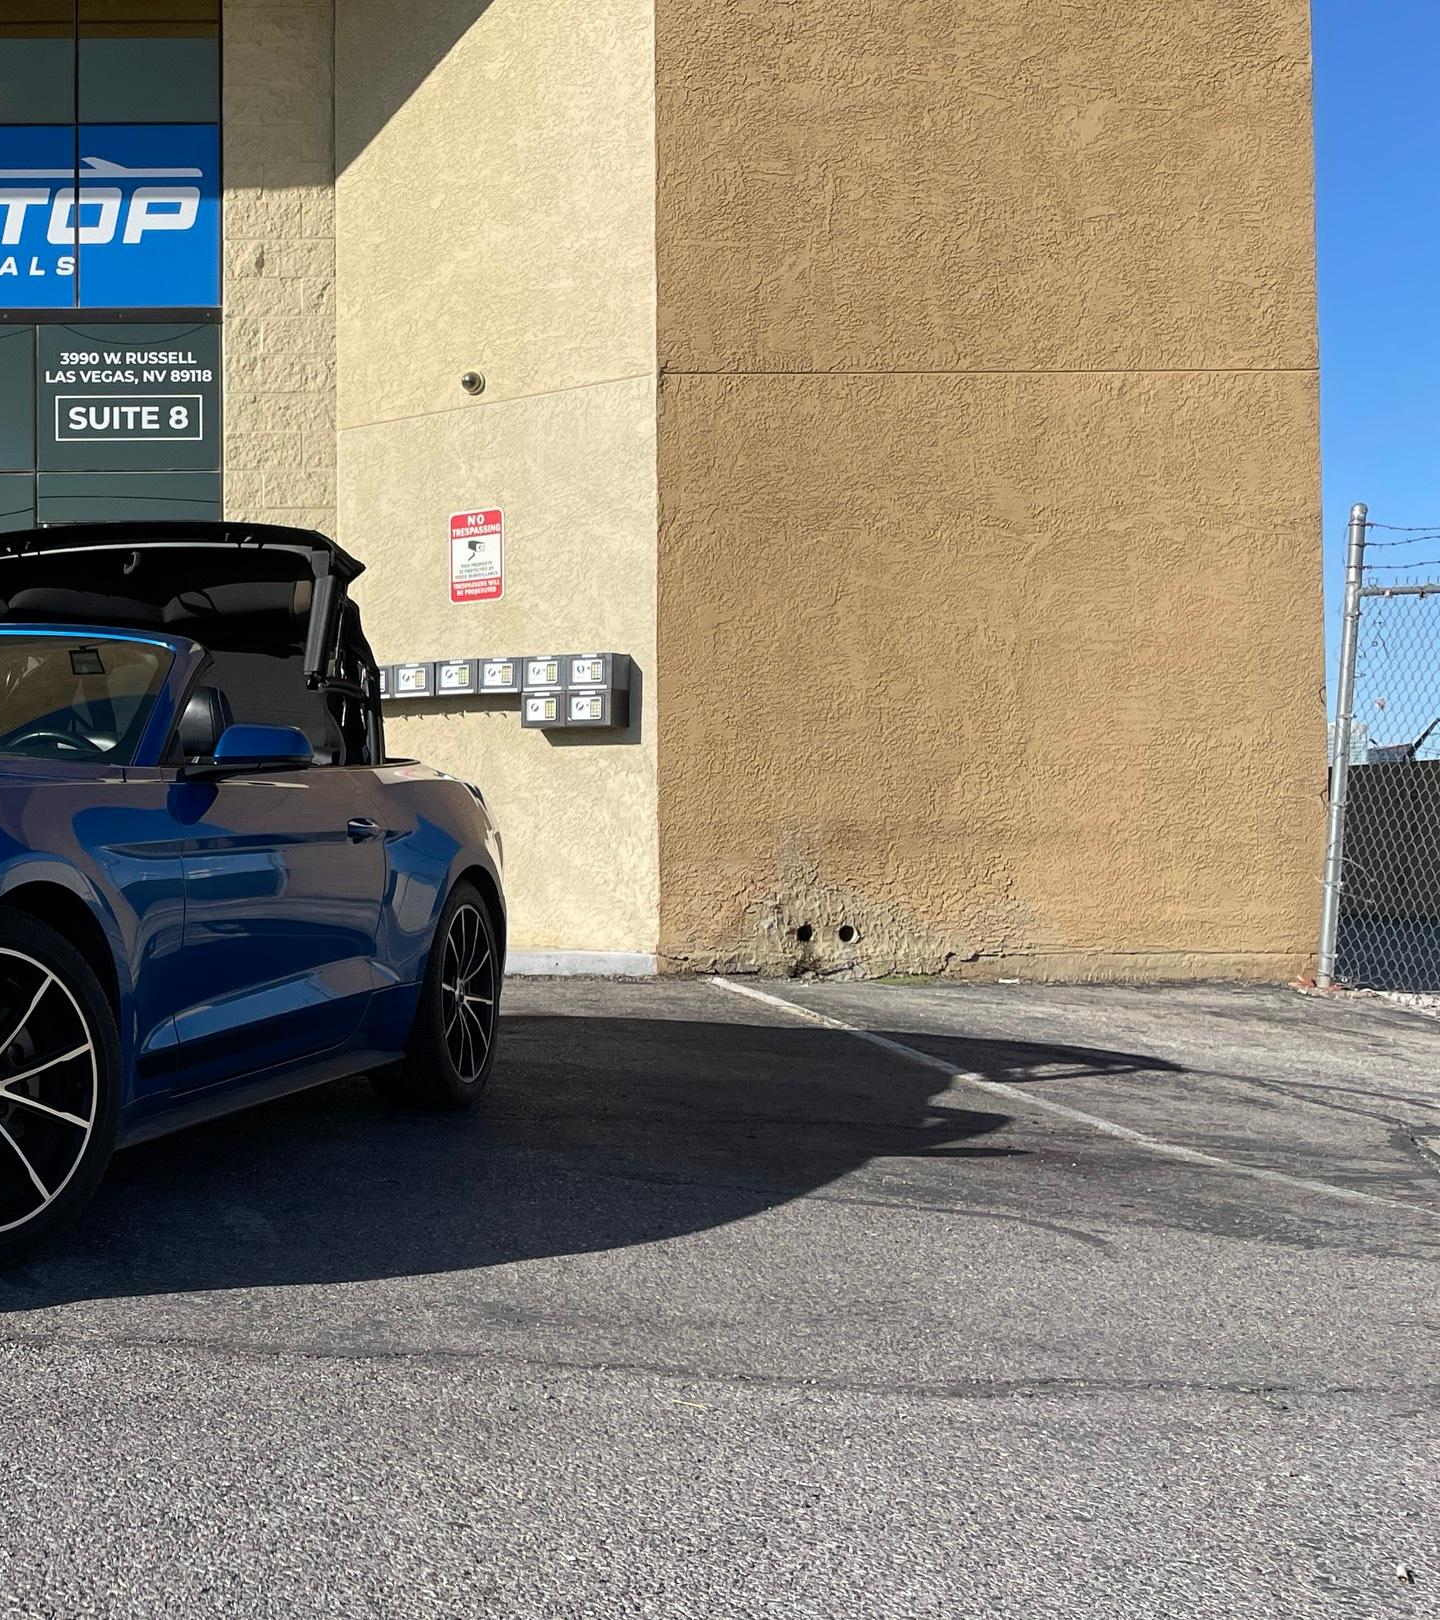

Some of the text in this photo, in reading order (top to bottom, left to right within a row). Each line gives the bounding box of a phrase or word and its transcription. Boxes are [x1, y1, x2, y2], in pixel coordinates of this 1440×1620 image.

[59, 351, 198, 366] 3990 W. RUSSELL
[45, 369, 213, 385] LAS VEGAS, NV 89118
[68, 405, 189, 430] SUITE 8
[467, 513, 485, 526] NO
[451, 523, 501, 538] TRESPASSING
